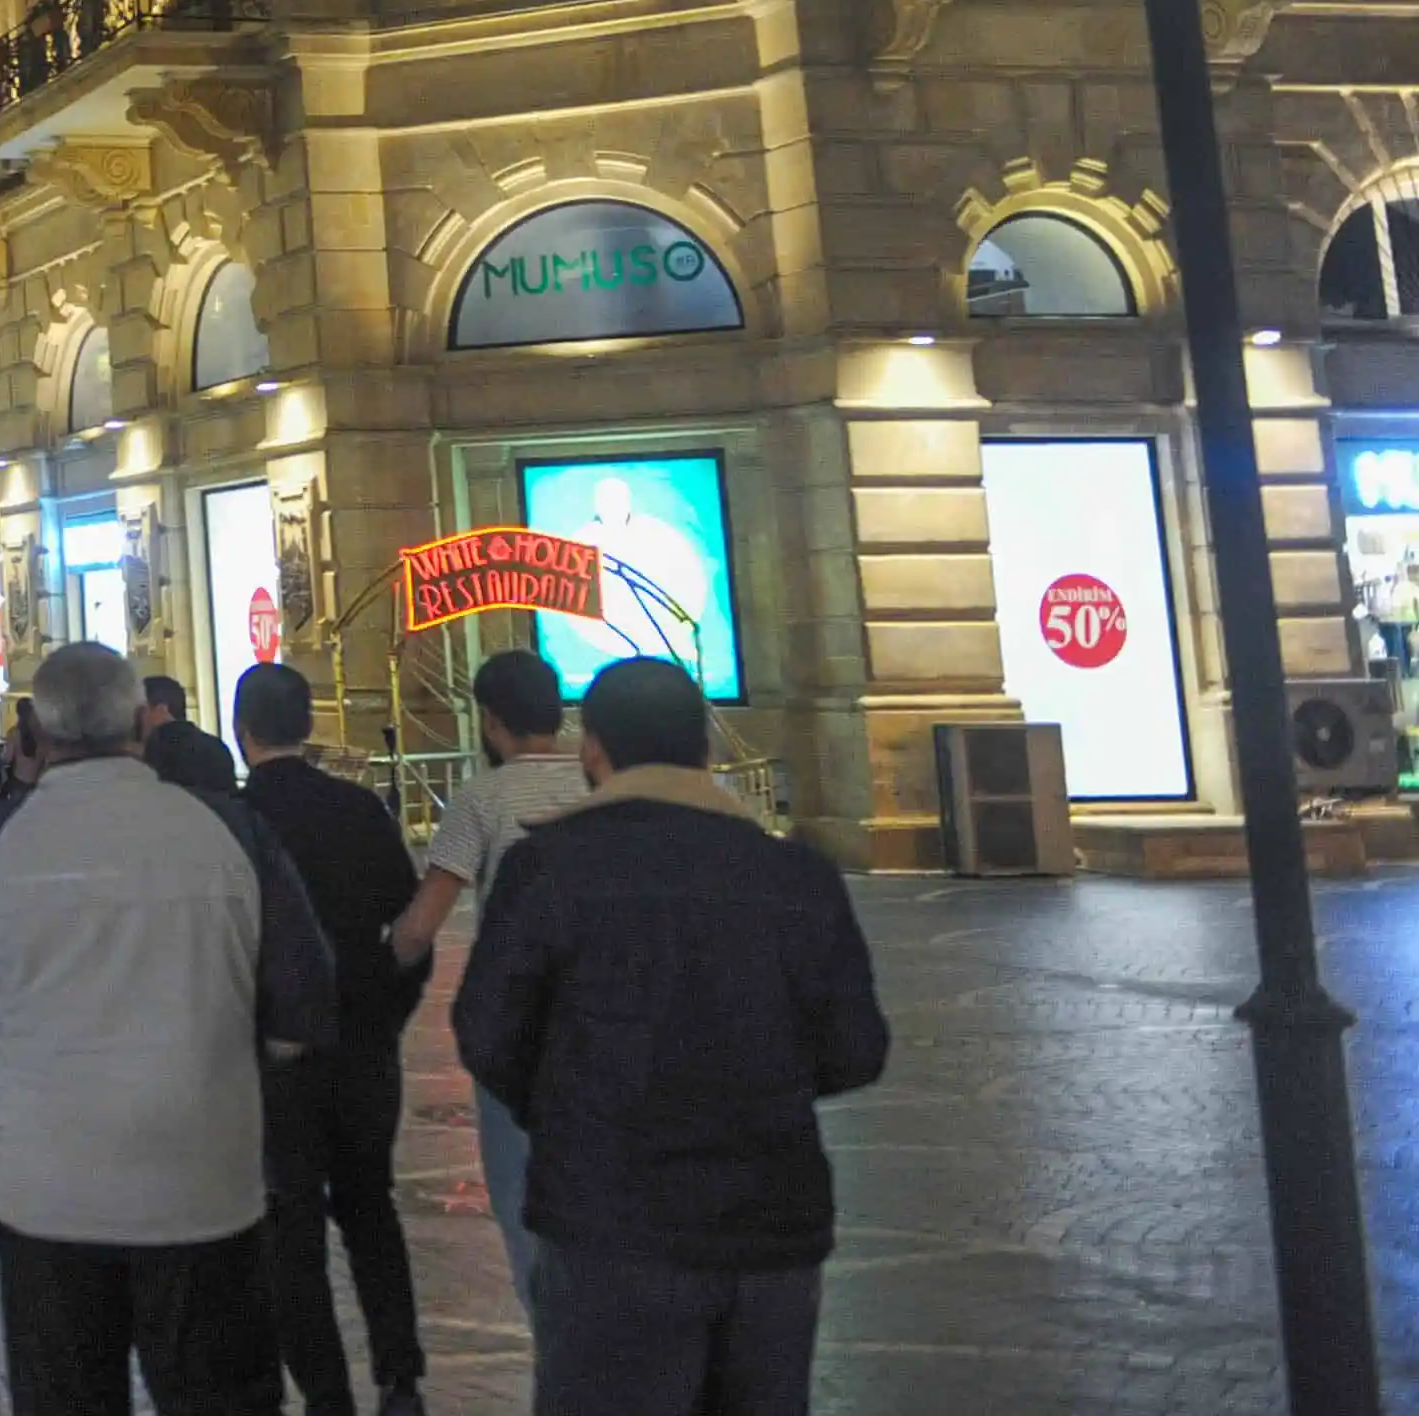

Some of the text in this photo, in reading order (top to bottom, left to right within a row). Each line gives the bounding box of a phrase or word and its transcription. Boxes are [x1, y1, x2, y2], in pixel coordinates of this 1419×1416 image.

[482, 240, 705, 299] MUMUSO
[412, 534, 595, 580] WHITE HOUSE
[418, 569, 590, 619] RESTAURANT
[1046, 604, 1126, 649] 50%
